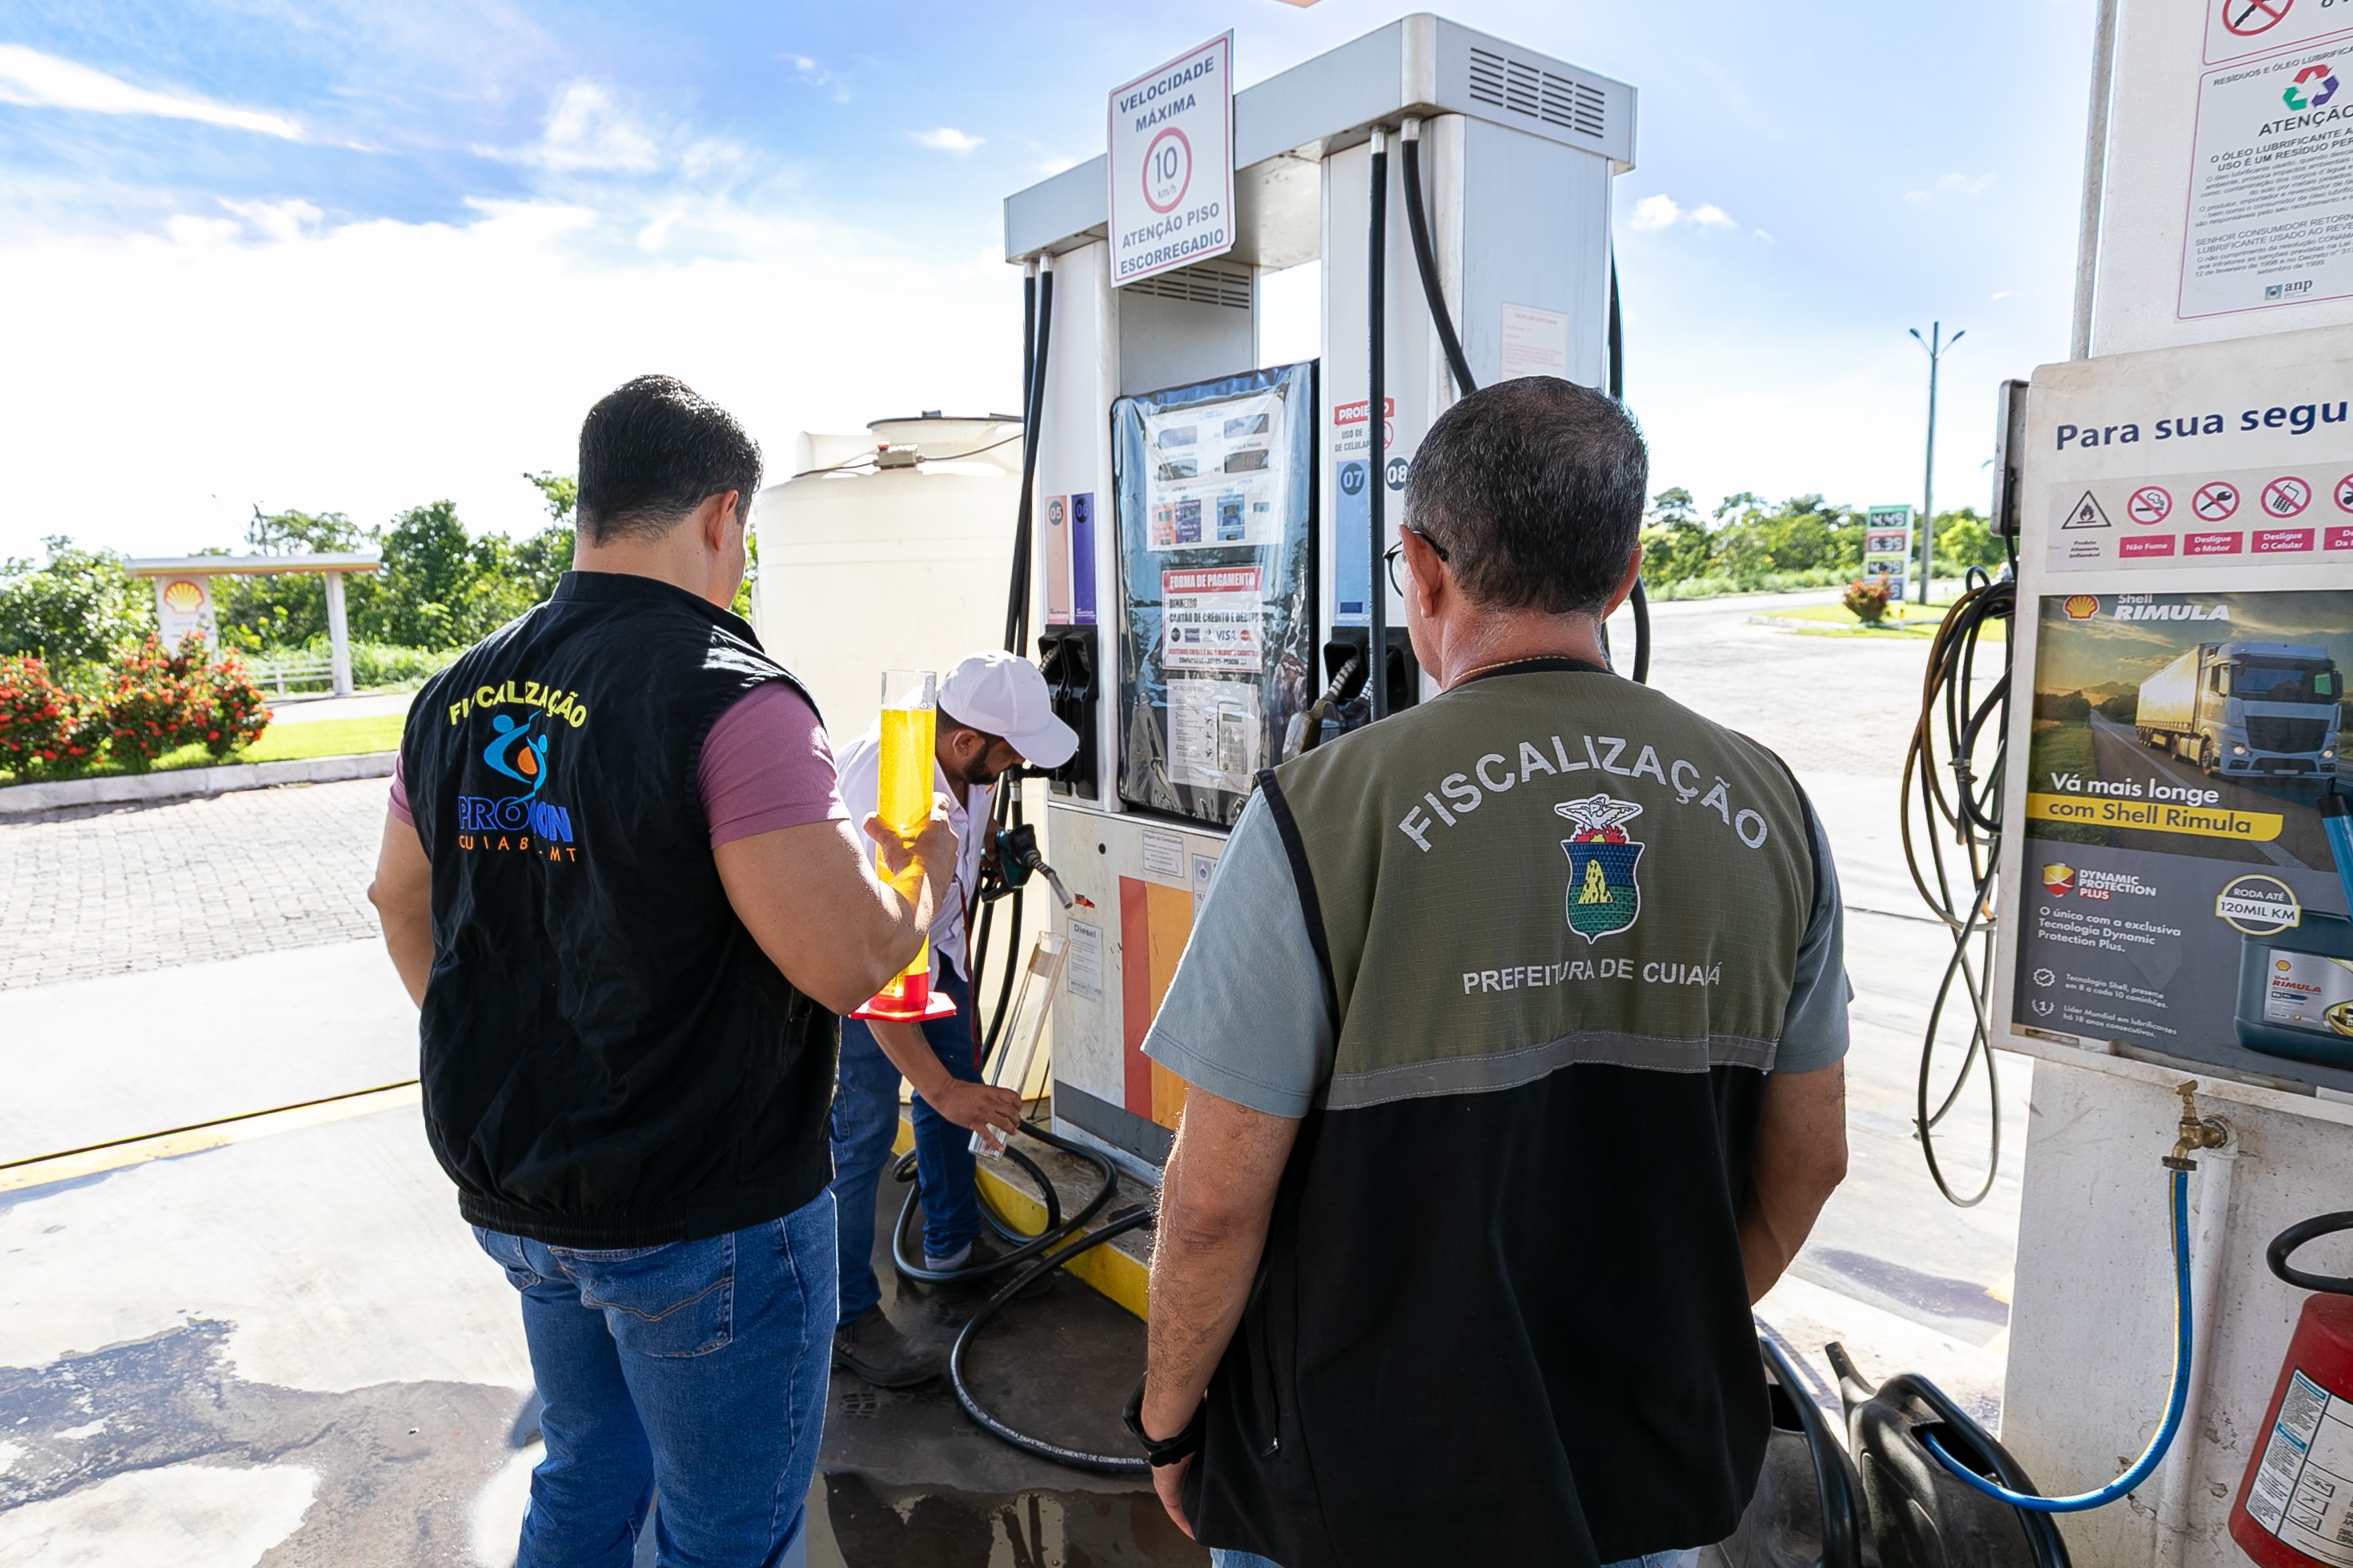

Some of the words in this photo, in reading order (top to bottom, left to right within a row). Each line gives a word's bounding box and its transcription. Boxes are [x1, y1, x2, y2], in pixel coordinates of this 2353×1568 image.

[2214, 69, 2261, 86] RESÍDUOS
[2263, 66, 2271, 74] E
[2272, 59, 2300, 72] ÓLEO
[1119, 56, 1215, 113] VELOCIDADE
[1135, 93, 1196, 132] MÁXIMA
[2258, 104, 2353, 138] ATENÇÃO
[2210, 155, 2219, 163] O
[2222, 148, 2254, 161] ÓLEO
[2256, 129, 2342, 154] LUBRIFICANTE
[1155, 146, 1178, 183] 10
[2218, 161, 2242, 171] USO
[2244, 157, 2252, 166] É
[2255, 154, 2272, 164] UM
[2275, 142, 2328, 160] RESÍDUO
[1157, 184, 1177, 199] km/h
[1122, 215, 1183, 249] ATENÇÃO
[1187, 202, 1219, 227] PISO
[2195, 233, 2236, 247] SENHOR
[2238, 221, 2307, 239] CONSUMIDOR
[2197, 237, 2267, 255] LUBRIFICANTE
[2270, 230, 2306, 243] USADO
[2307, 227, 2323, 236] AO
[1121, 229, 1224, 275] ESCORREGADIO
[2284, 279, 2313, 292] anp
[1342, 429, 1354, 439] USO
[1355, 428, 1363, 437] DE
[2057, 423, 2139, 451] Para
[2154, 413, 2224, 440] sua
[2240, 400, 2347, 435] segu
[1335, 443, 1343, 452] DE
[1343, 470, 1363, 488] 07
[1387, 464, 1408, 483] 08
[1050, 507, 1062, 520] 05
[1076, 503, 1089, 518] 06
[2194, 535, 2231, 544] Desligue
[2263, 532, 2303, 541] Desligue
[2271, 541, 2304, 549] Celular
[1170, 574, 1196, 589] FORMA
[1196, 573, 1207, 588] DE
[1207, 571, 1255, 587] PAGAMENTO
[2118, 594, 2153, 604] Shell
[1169, 612, 1193, 623] CARTÃO
[1194, 612, 1202, 623] DE
[1203, 610, 1230, 623] CRÉDITO
[2114, 604, 2230, 621] RIMULA
[1216, 628, 1237, 641] VISA
[1398, 735, 1768, 853] FISCALIZAÇÃO
[2050, 772, 2081, 792] Vá
[2087, 776, 2142, 798] mais
[2148, 778, 2220, 807] longe
[2049, 802, 2094, 819] com
[2102, 802, 2158, 825] Shell
[2166, 808, 2251, 834] Rimula
[2079, 869, 2139, 885] DYNAMIC
[2078, 878, 2157, 896] PROTECTION
[2079, 888, 2110, 900] PLUS
[2234, 888, 2264, 899] RODA
[2265, 891, 2285, 901] ATÉ
[2221, 901, 2267, 916] 120MIL
[2271, 908, 2295, 920] KM
[2039, 906, 2050, 916] O
[2053, 908, 2084, 920] único
[2086, 915, 2110, 925] com
[2113, 919, 2122, 927] a
[2124, 920, 2182, 936] exclusiva
[1074, 924, 1097, 938] Diesel
[2039, 917, 2100, 936] Tecnologia
[2102, 928, 2156, 945] Dynamic
[2038, 929, 2096, 947] Protection
[2098, 939, 2126, 952] Plus.
[1600, 958, 1634, 980] DE
[1642, 960, 1722, 986] CUIAÁ
[2065, 982, 2077, 990] em
[2093, 987, 2113, 997] cada
[2115, 990, 2124, 998] 10
[2066, 972, 2106, 988] Tecnologia
[2109, 981, 2130, 993] Shell,
[2131, 987, 2164, 1000] presente
[2272, 980, 2322, 993] RIMULA
[2038, 1001, 2047, 1012] 1
[2062, 1013, 2073, 1021] há
[2074, 1015, 2084, 1023] 18
[2085, 1018, 2105, 1027] anos
[2106, 1021, 2157, 1038] consecutivos.
[2063, 1005, 2082, 1014] Líder
[2084, 1009, 2116, 1021] Mundial
[2130, 1017, 2178, 1035] lubrificantes
[1088, 1454, 1098, 1462] DE
